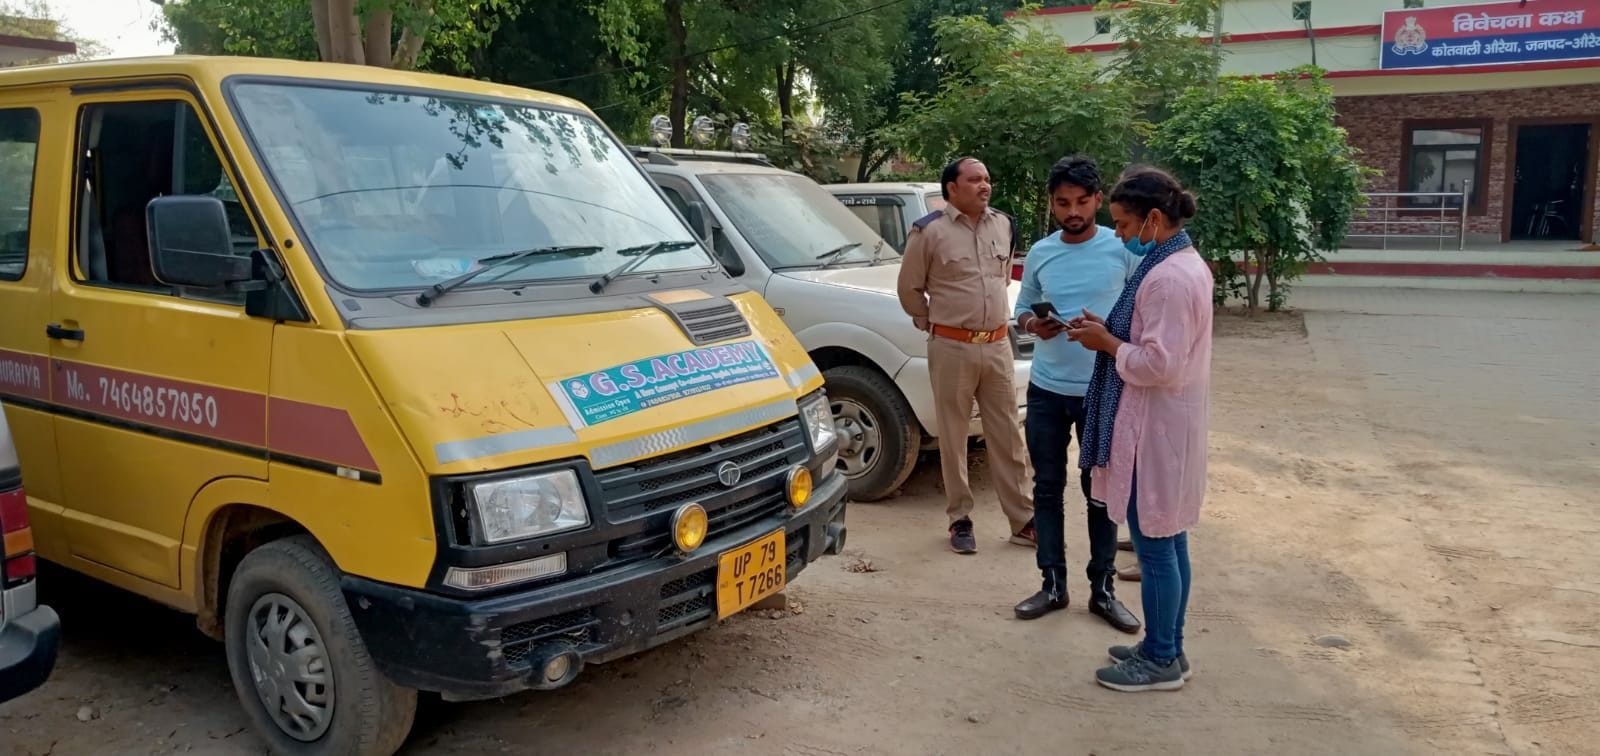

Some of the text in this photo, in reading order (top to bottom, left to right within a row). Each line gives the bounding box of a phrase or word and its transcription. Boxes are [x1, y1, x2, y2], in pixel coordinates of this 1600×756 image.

[1453, 10, 1585, 32] विवेचना कक्ष
[1431, 40, 1481, 57] कोतवाली
[1525, 32, 1600, 51] जनपद-औरैय
[99, 376, 218, 428] 7464857950
[733, 540, 776, 578] UP 79
[736, 564, 782, 606] T 7266
